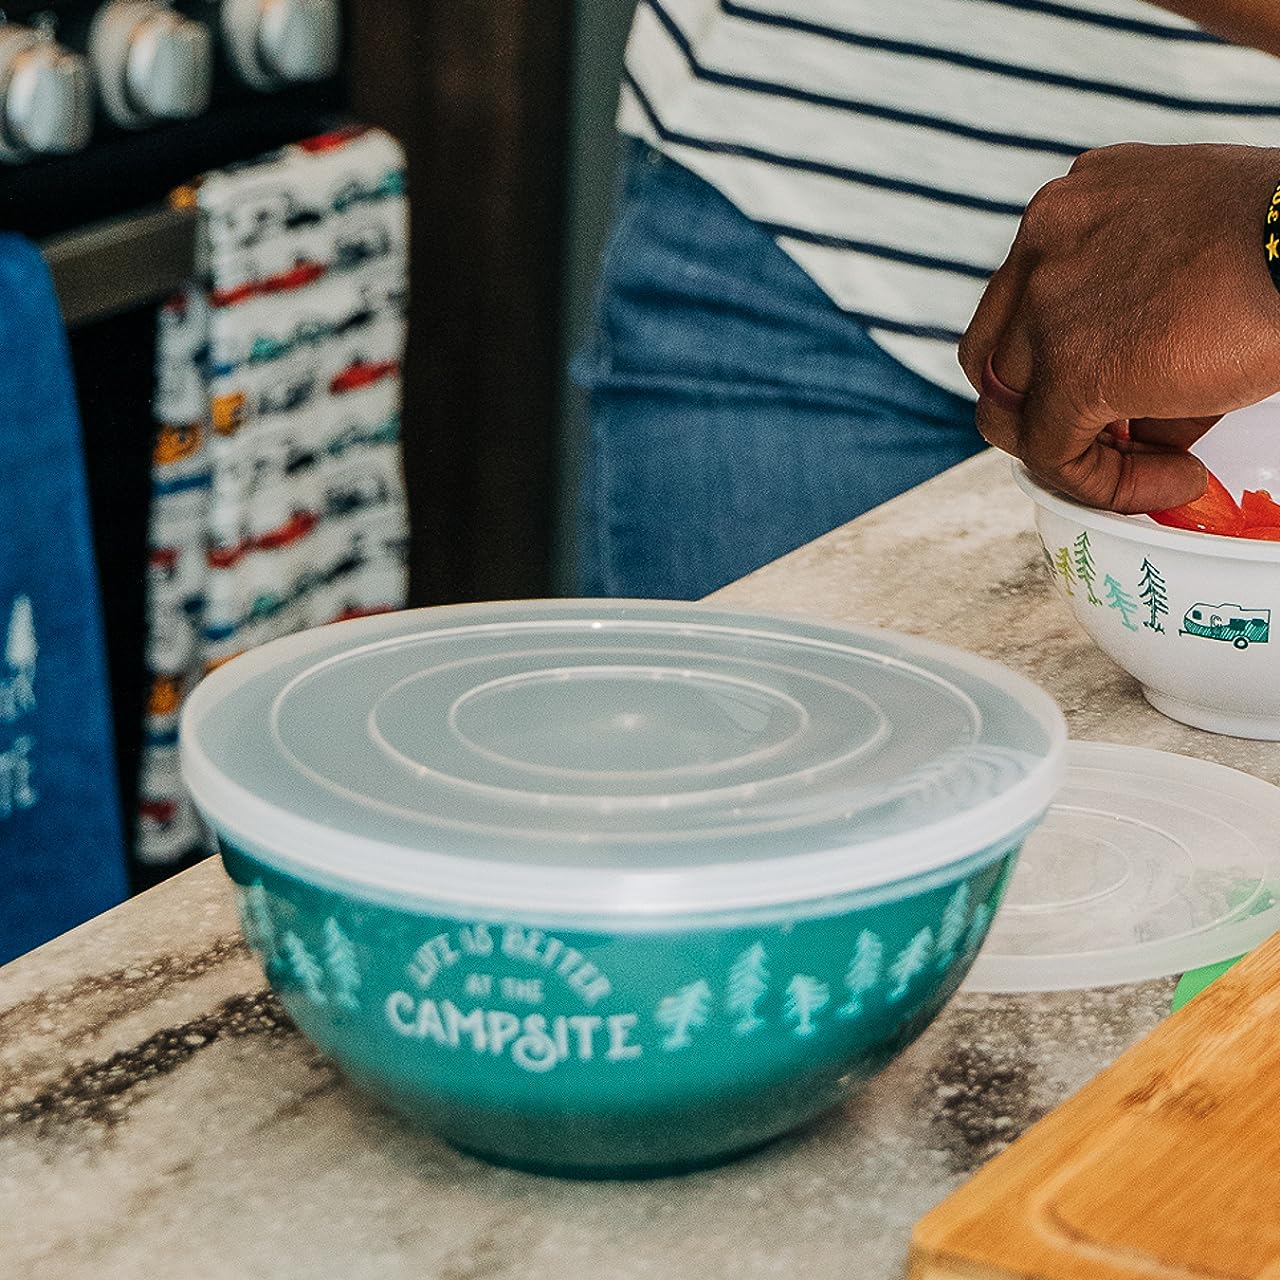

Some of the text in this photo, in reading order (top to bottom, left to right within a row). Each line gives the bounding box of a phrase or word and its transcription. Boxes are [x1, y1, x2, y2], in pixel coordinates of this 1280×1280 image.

[406, 923, 612, 1006] LIFE IS BETTER
[466, 973, 544, 1004] AT THE
[384, 989, 642, 1072] CAMPSITE
